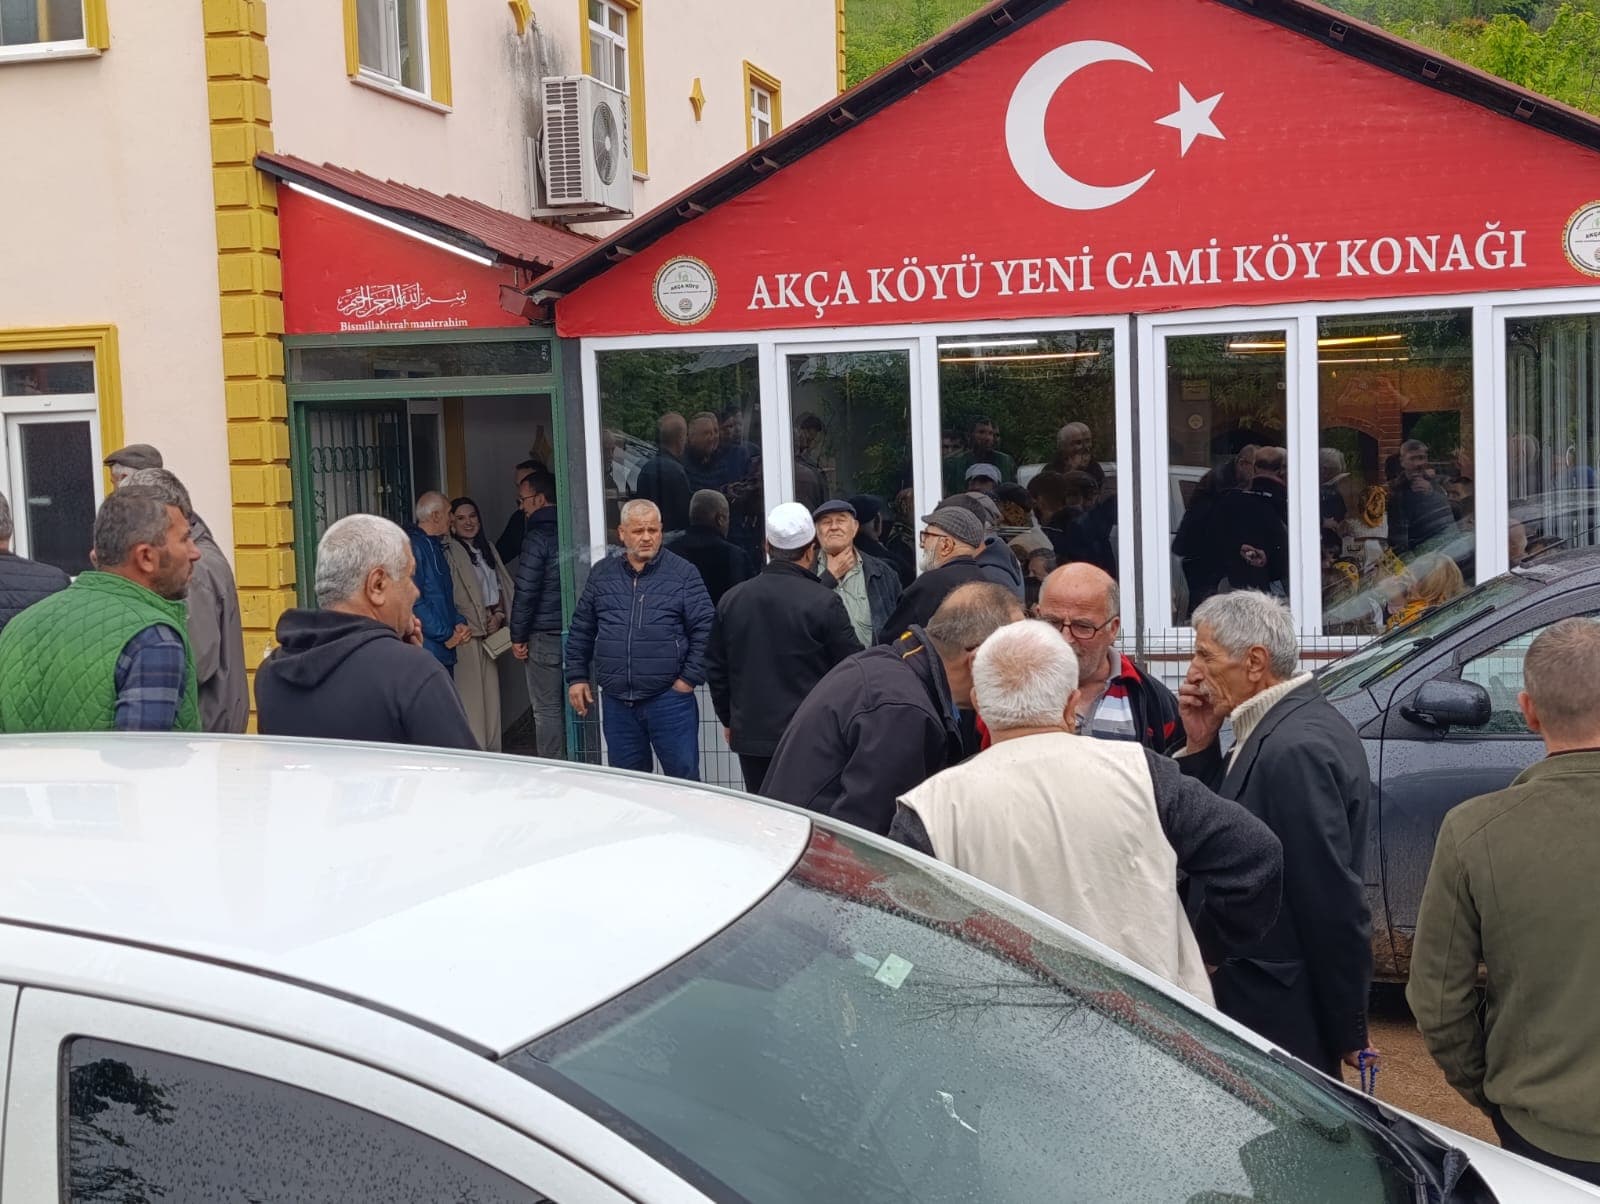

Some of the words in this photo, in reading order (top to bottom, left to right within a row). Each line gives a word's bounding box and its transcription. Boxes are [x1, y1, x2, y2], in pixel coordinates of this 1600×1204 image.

[747, 270, 860, 319] AKÇA
[867, 253, 984, 304] KÖYÜ
[990, 245, 1095, 296] YENİ
[1105, 238, 1222, 290] CAMİ
[1232, 233, 1328, 283] KÖY
[1336, 221, 1527, 277] KONAĞI
[340, 318, 468, 331] Bismillahirrahmanirrahim
